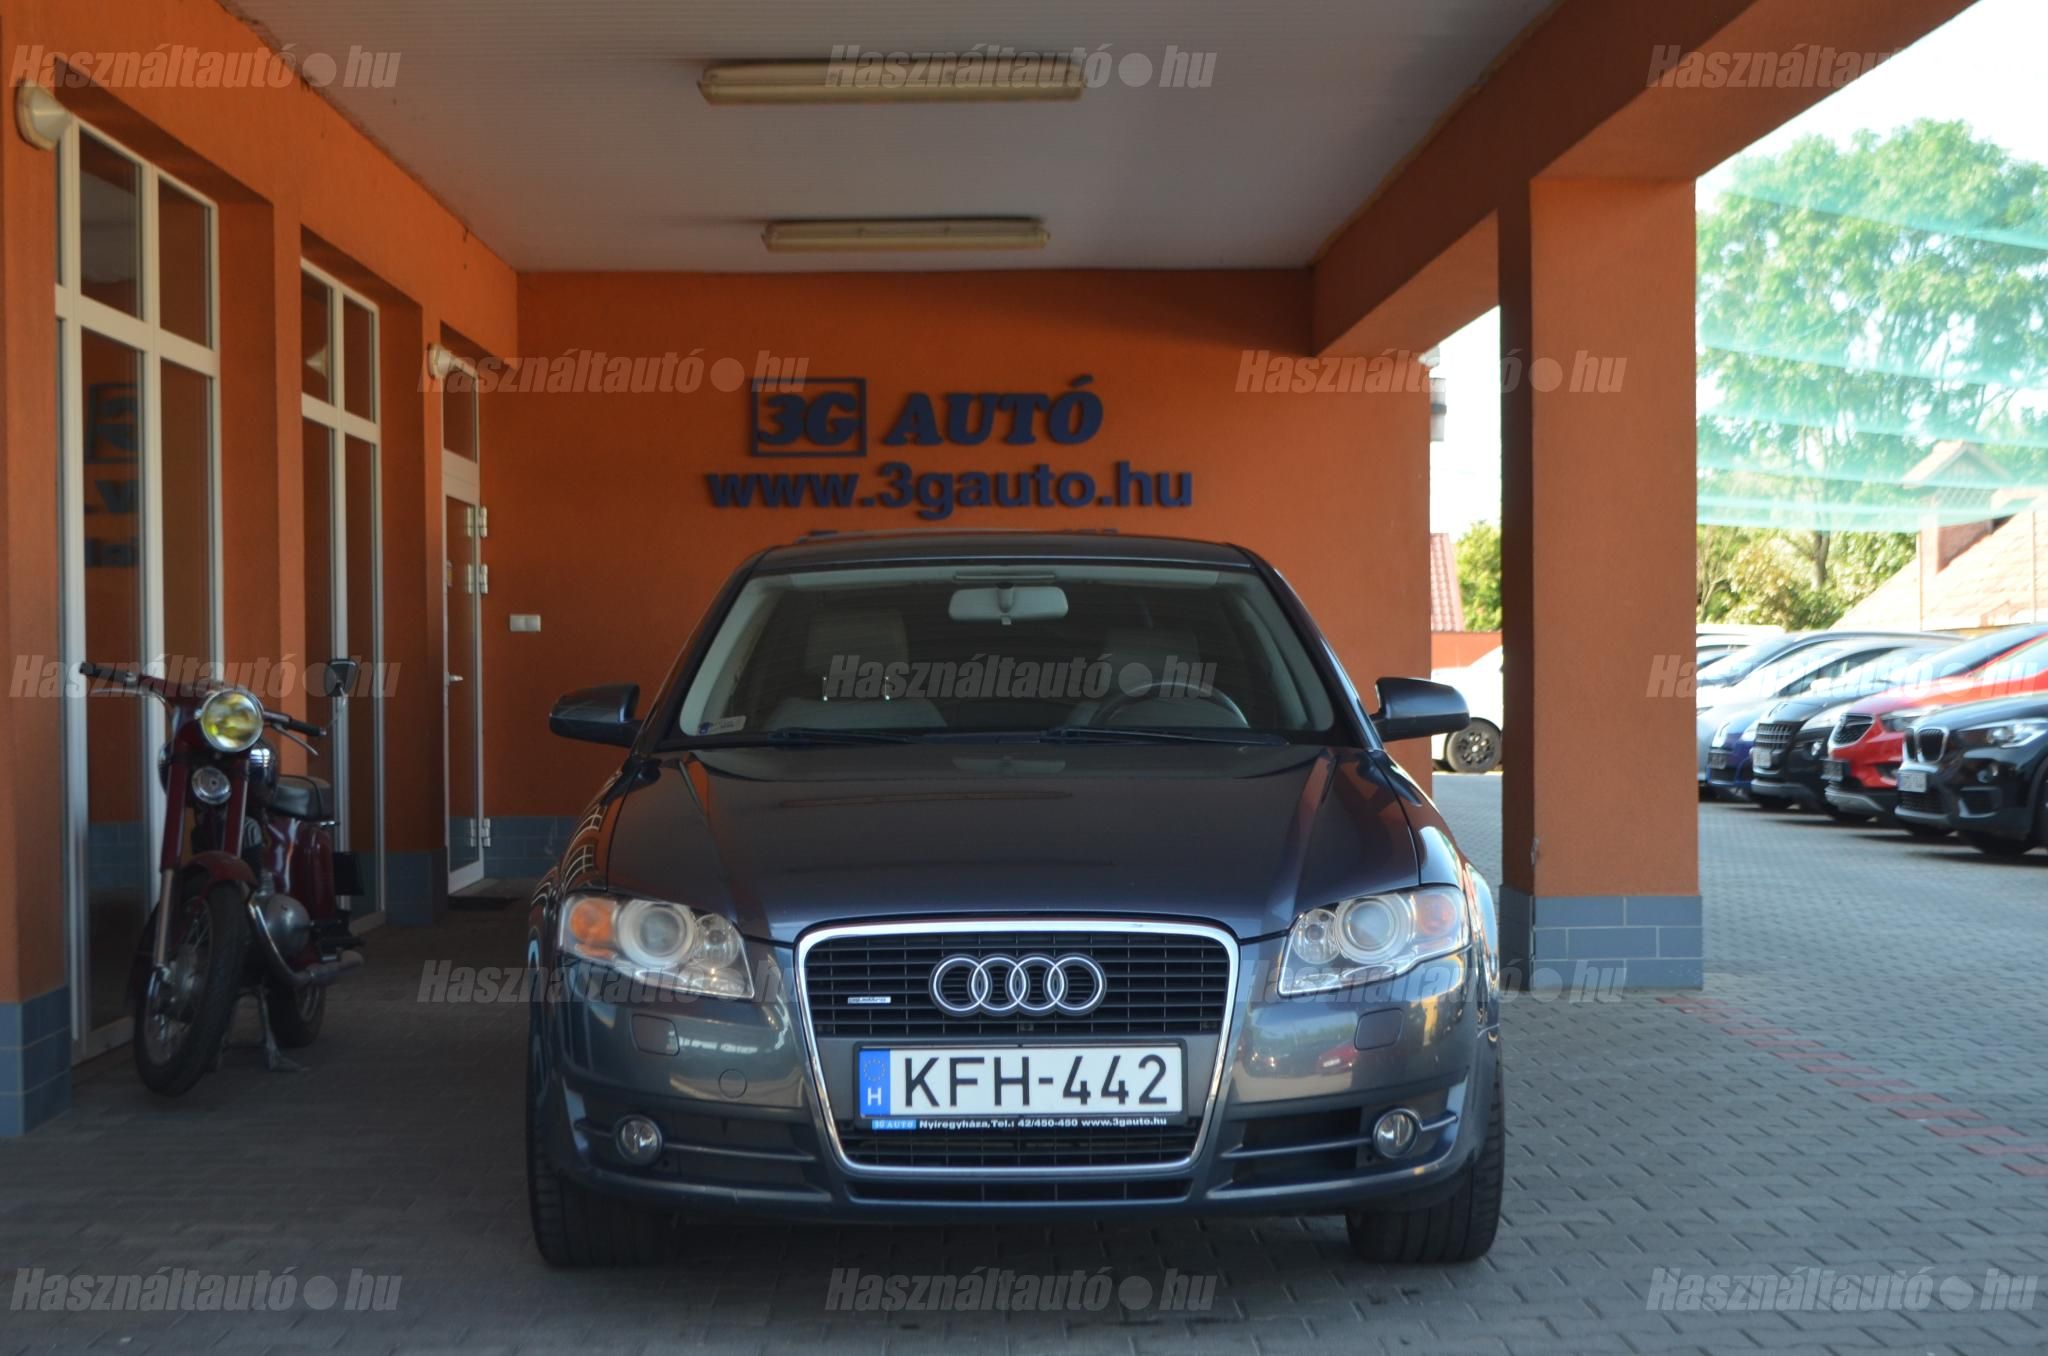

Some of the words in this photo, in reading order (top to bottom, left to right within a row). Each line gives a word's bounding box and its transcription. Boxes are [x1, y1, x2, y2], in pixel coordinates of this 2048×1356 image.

[756, 391, 861, 446] 3G
[883, 374, 1105, 447] AUTÓ
[706, 460, 1194, 521] www.3gauto.hu
[866, 1086, 883, 1107] H
[903, 1055, 1168, 1108] KFH-442
[1018, 1118, 1078, 1129] 42/450-450
[1081, 1116, 1167, 1128] www.3gauto.hu
